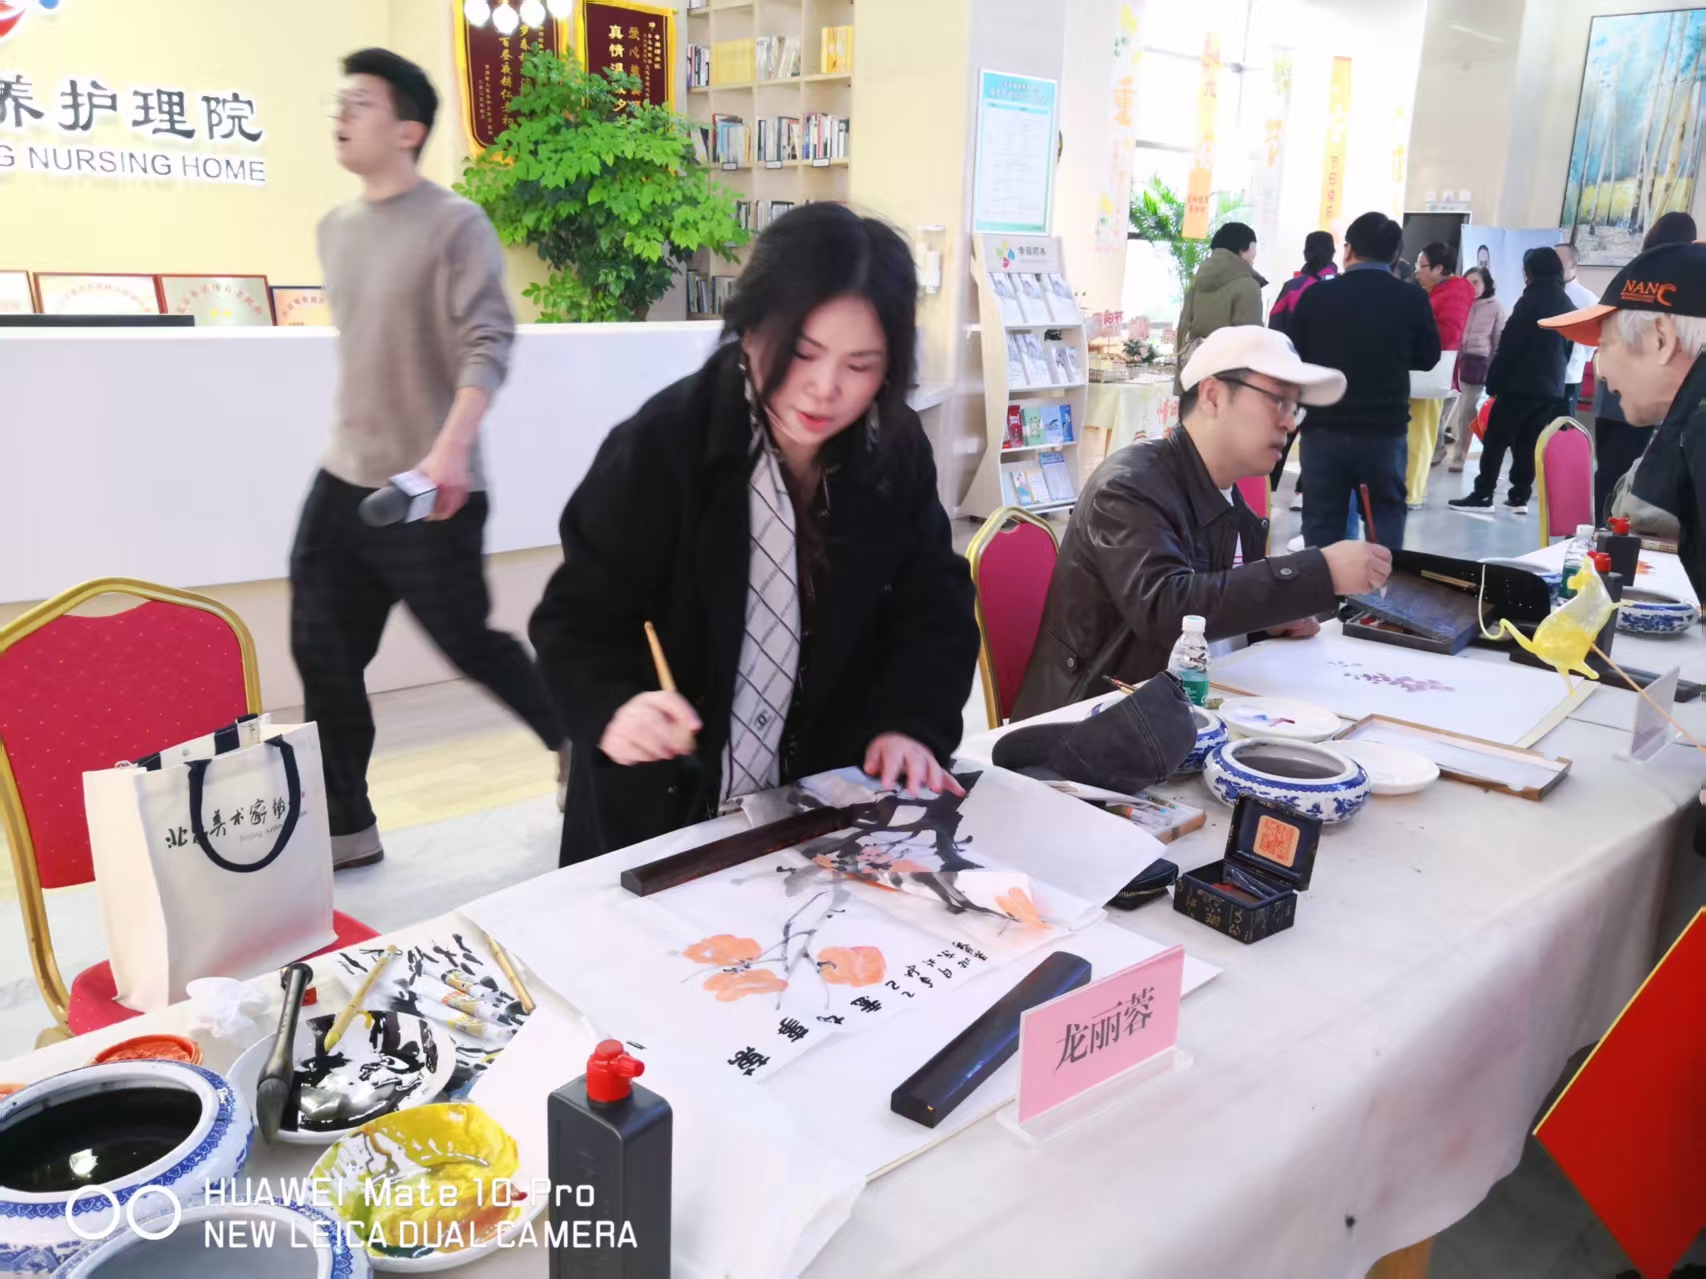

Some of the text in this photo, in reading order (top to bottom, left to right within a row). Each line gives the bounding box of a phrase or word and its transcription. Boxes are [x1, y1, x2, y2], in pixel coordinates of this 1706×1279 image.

[29, 146, 171, 176] NURSING
[182, 155, 266, 181] HOME
[1055, 987, 1155, 1072] 龙丽蓉
